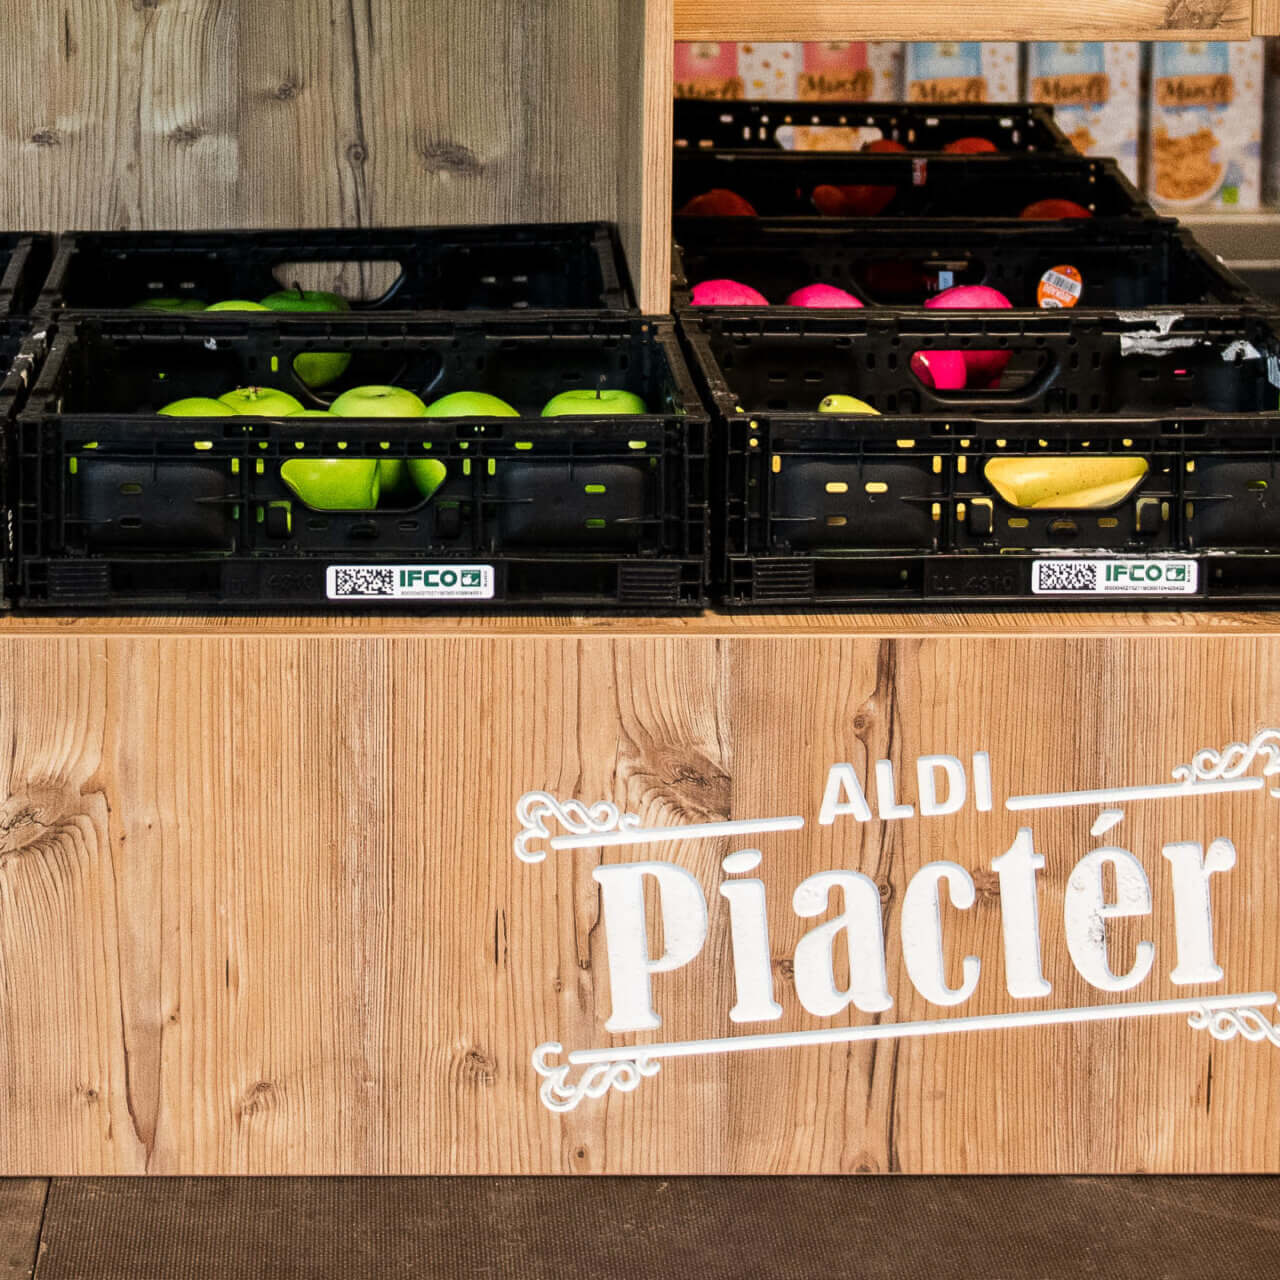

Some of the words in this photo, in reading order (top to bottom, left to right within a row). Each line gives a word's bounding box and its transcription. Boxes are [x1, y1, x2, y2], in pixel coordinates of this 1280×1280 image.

[400, 570, 458, 587] IFCO
[1105, 564, 1163, 582] IFCO
[818, 750, 992, 825] ALDI
[592, 809, 1237, 1032] Piactér
